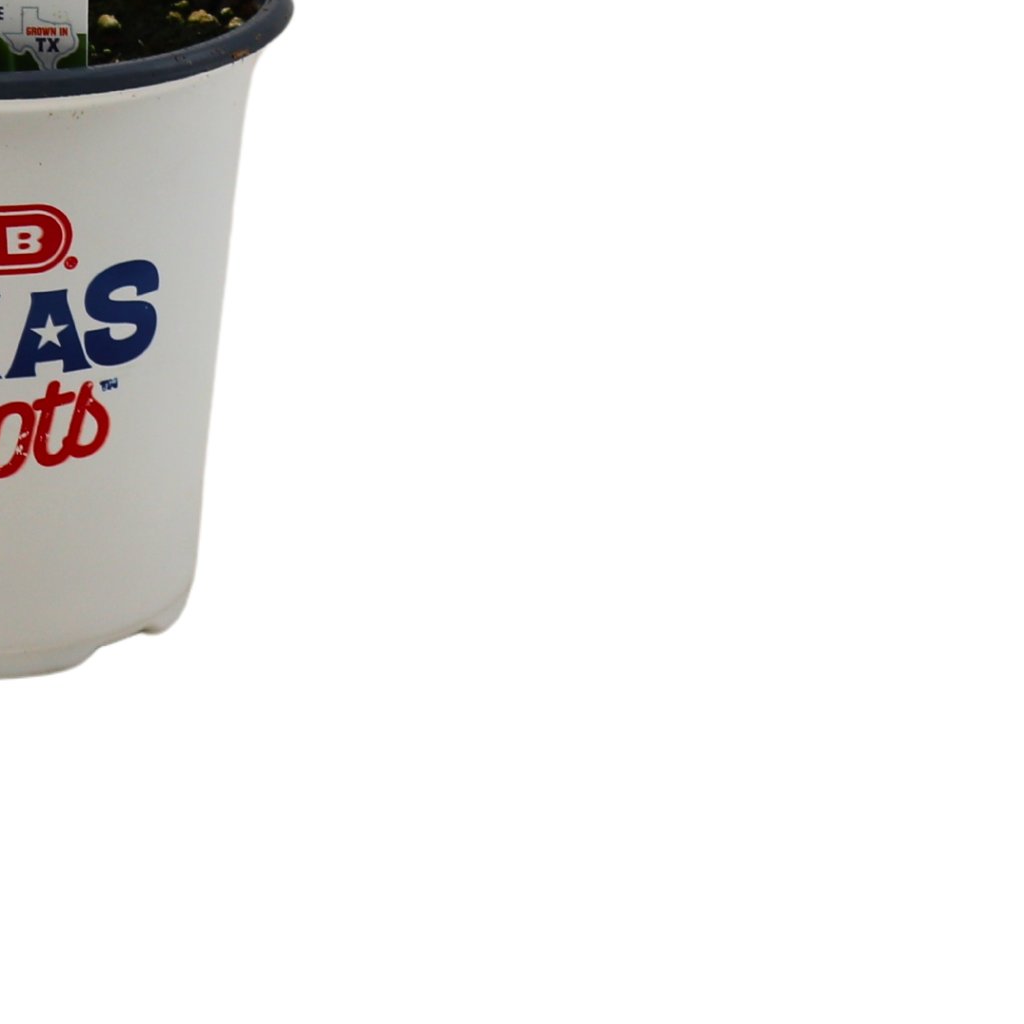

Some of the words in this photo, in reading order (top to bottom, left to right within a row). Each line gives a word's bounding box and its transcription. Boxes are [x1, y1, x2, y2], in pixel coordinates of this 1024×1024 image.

[26, 27, 57, 36] GROWN
[59, 27, 69, 36] IN
[35, 38, 60, 53] TX
